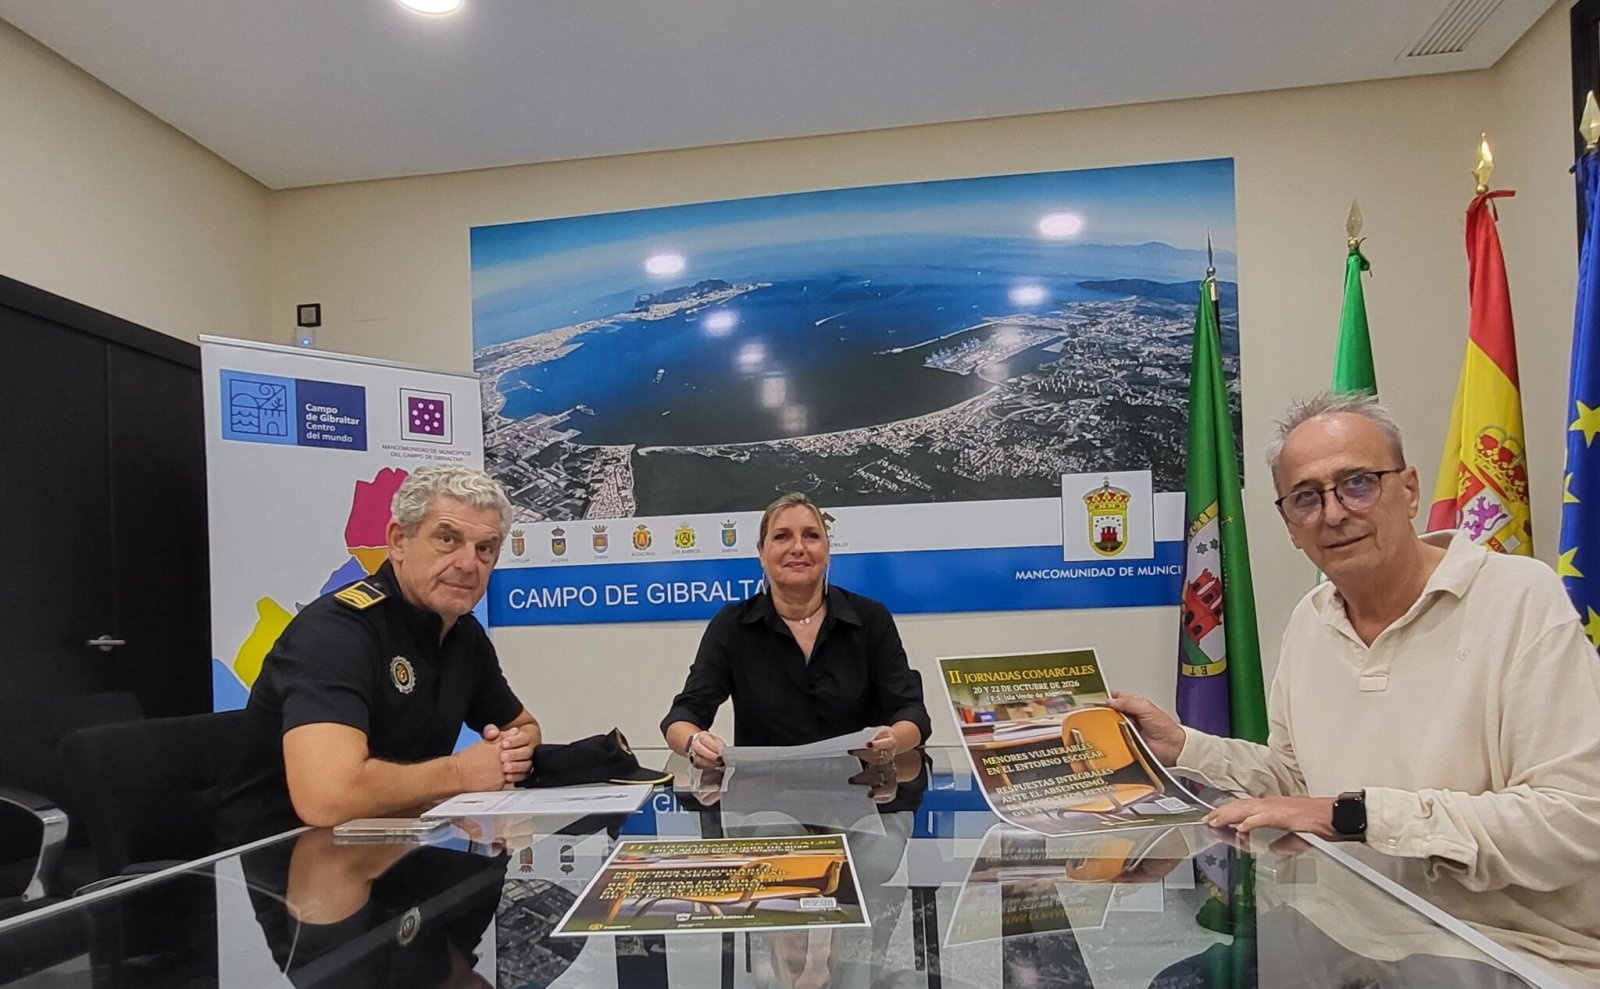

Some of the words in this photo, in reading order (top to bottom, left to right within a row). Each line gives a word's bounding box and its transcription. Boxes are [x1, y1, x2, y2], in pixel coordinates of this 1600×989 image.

[305, 403, 338, 415] Campo
[305, 412, 318, 421] de
[319, 413, 360, 425] Gibraltar
[305, 421, 336, 432] Centro
[306, 430, 320, 440] del
[322, 434, 353, 443] mundo
[382, 444, 429, 453] MANCOMUNIDAD
[438, 449, 471, 457] MUNICIPIOS
[403, 452, 424, 460] CAMPO
[1015, 567, 1116, 580] MANCOMUNIDAD
[1118, 566, 1135, 577] DE
[1137, 564, 1183, 577] MUNICI
[508, 586, 598, 610] CAMPO
[605, 583, 640, 607] DE
[646, 579, 767, 605] GIBRALTA
[948, 670, 962, 684] II
[964, 671, 1020, 684] JORNADAS
[1022, 664, 1095, 679] COMARCALES
[972, 686, 982, 694] 20
[984, 685, 990, 693] Y
[991, 685, 1000, 693] 22
[1001, 684, 1012, 692] DE
[1013, 682, 1049, 691] OCTUBRE
[1049, 681, 1060, 690] DE
[1016, 692, 1034, 700] Verde
[982, 752, 1028, 766] MENORES
[1028, 743, 1094, 759] VULNERABLES
[986, 766, 1001, 776] EN
[1002, 764, 1016, 774] EL
[1015, 757, 1062, 772] ENTORNO
[1062, 750, 1105, 764] ESCOLAR
[995, 779, 1056, 795] RESPUESTAS
[1055, 768, 1114, 784] INTEGRALES
[1001, 792, 1029, 804] ANTE
[1030, 789, 1043, 799] EL
[1043, 779, 1108, 796] ABSENTISMO,
[1082, 784, 1116, 797] RETOS
